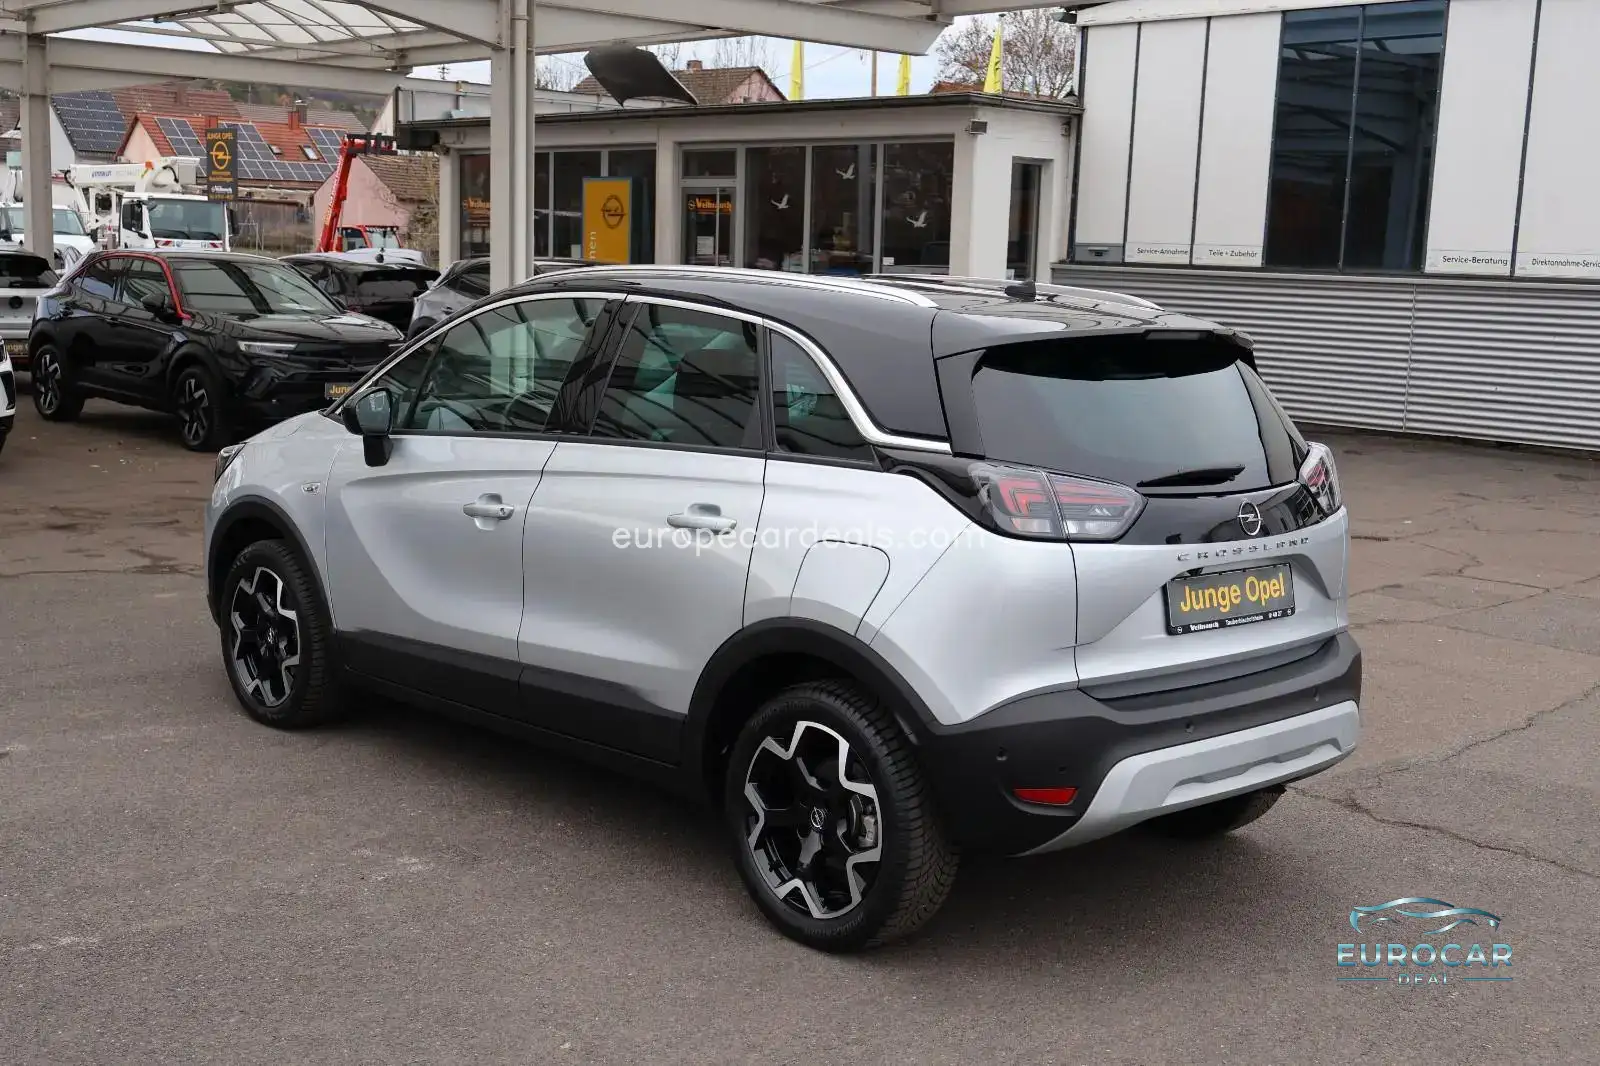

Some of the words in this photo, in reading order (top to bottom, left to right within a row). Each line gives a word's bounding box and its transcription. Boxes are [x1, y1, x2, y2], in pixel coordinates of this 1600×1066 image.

[1137, 248, 1189, 256] Service-Annahme
[1208, 249, 1224, 257] Teile
[1442, 255, 1508, 266] Service-Beratung
[1180, 583, 1241, 612] Junge
[1245, 573, 1285, 605] Opel
